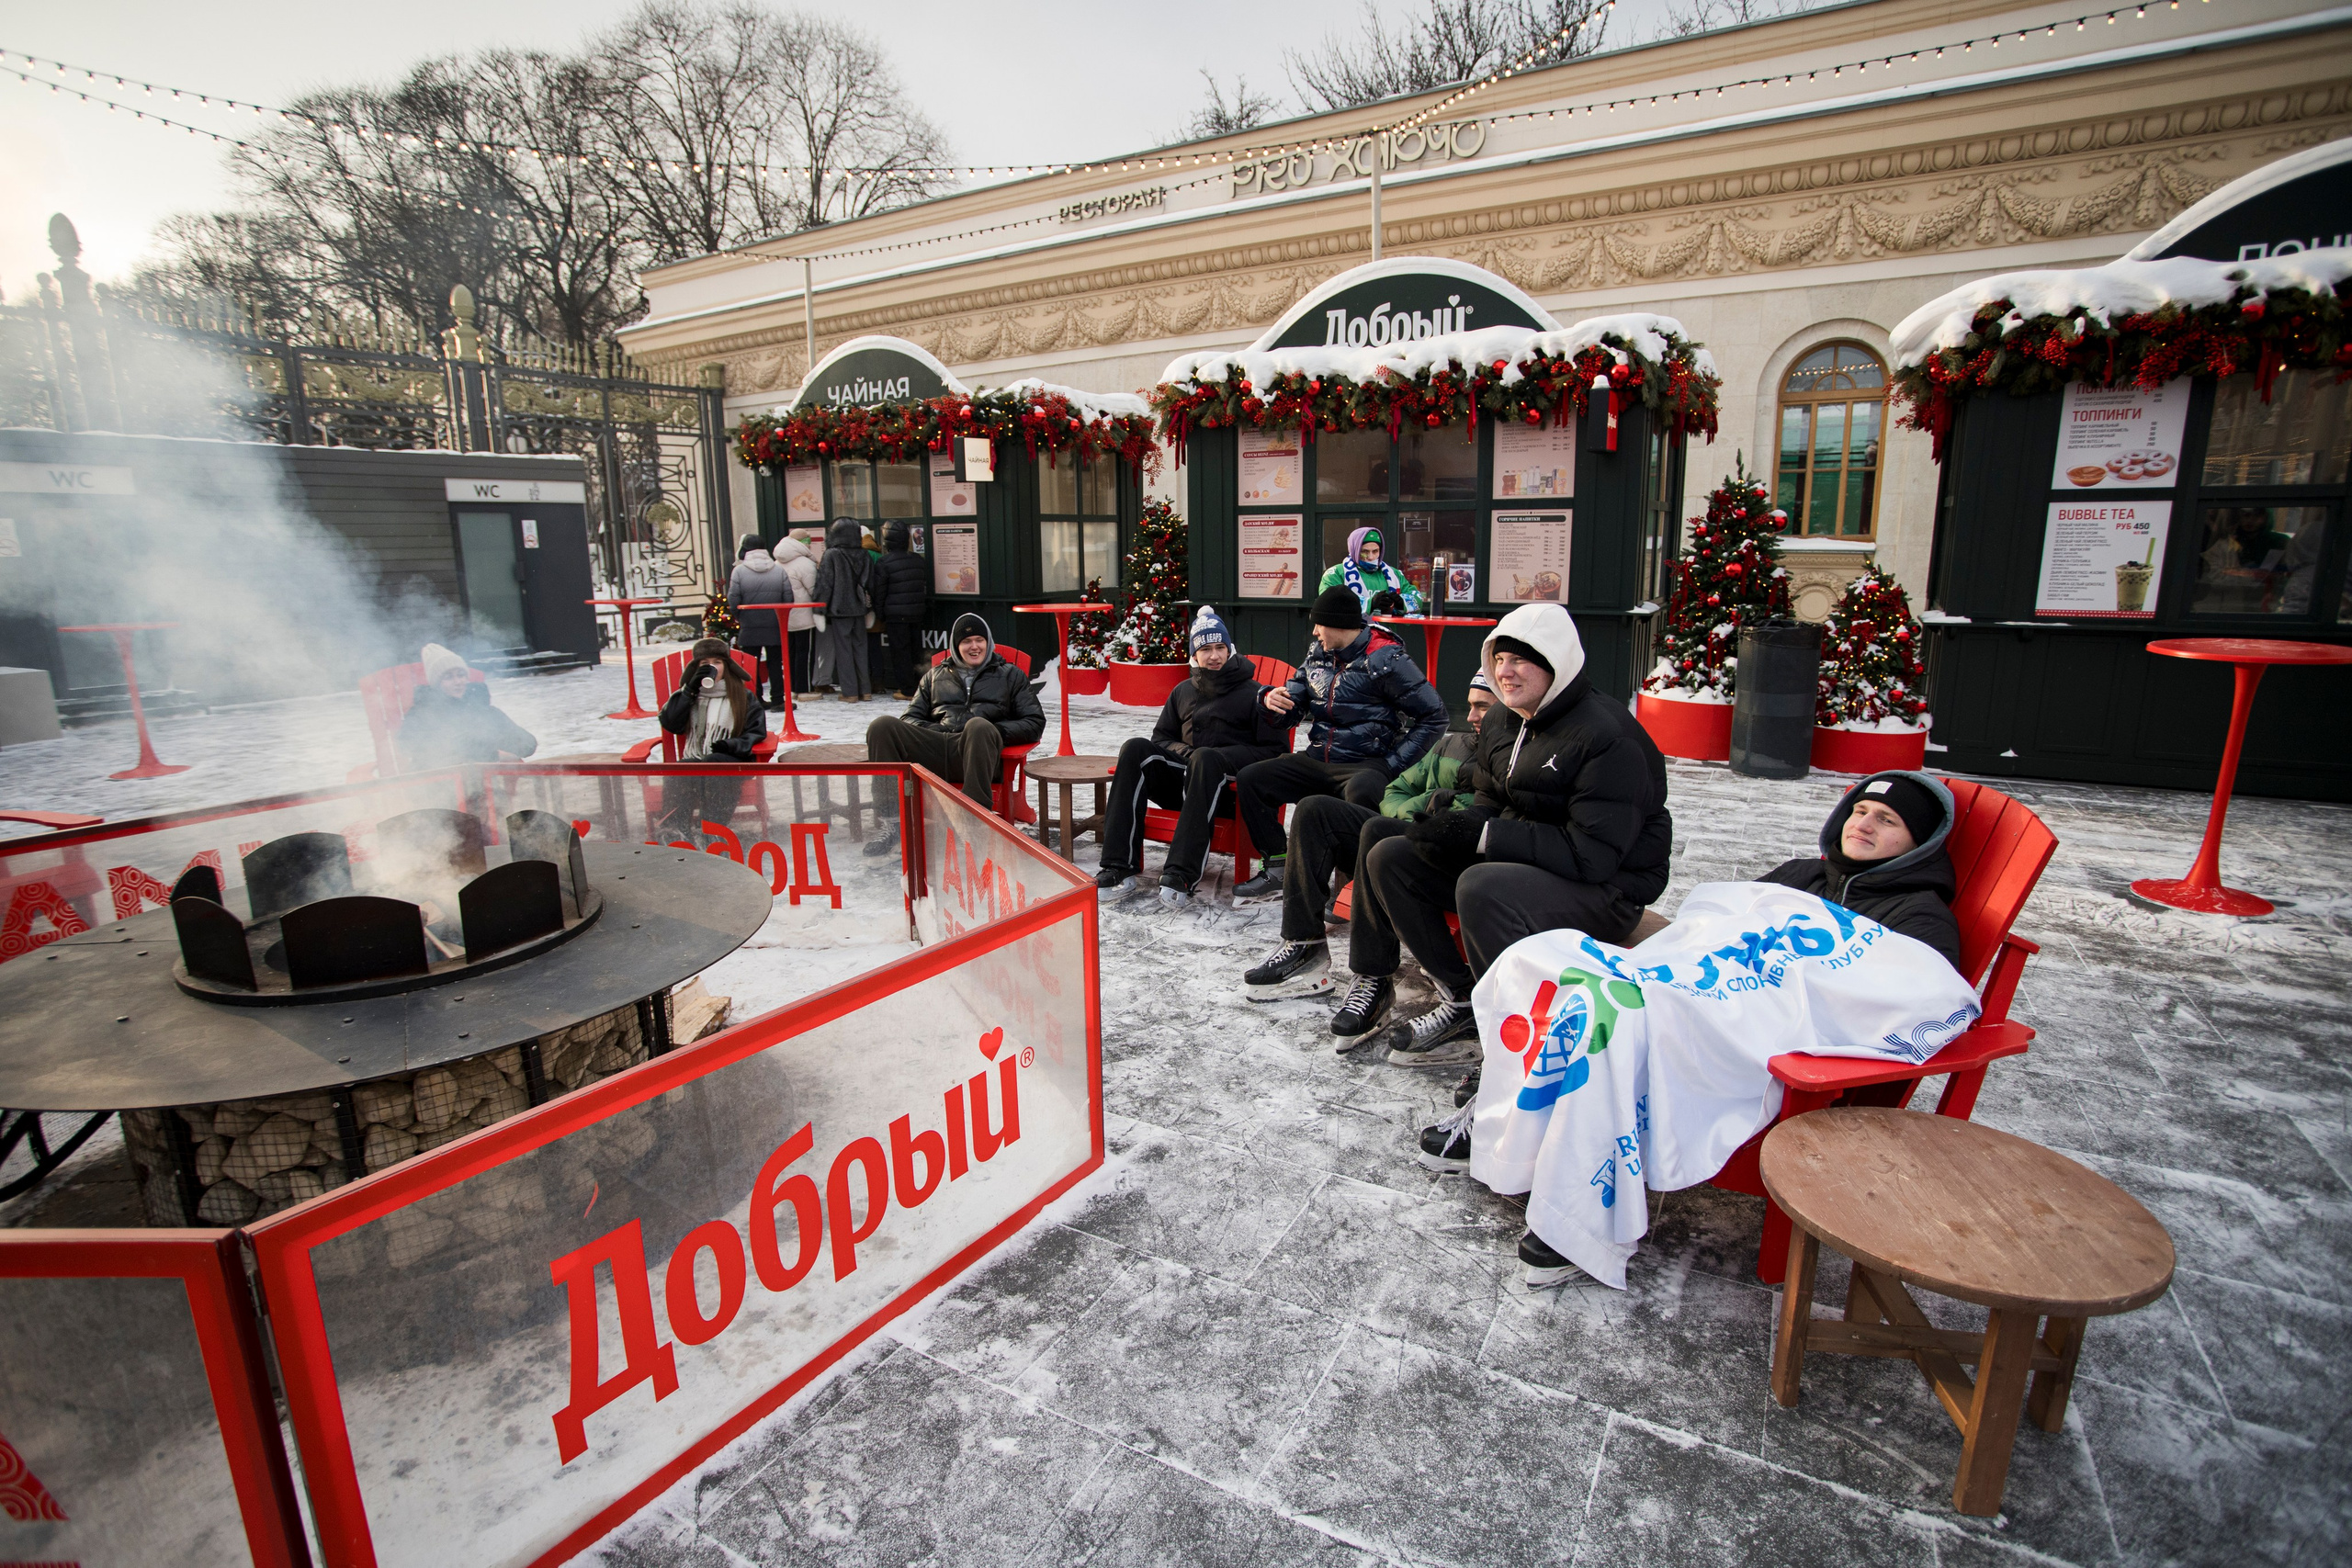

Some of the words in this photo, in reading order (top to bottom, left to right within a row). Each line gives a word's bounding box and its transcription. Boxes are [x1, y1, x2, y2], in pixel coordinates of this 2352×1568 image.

[1059, 186, 1163, 224] РЕСТОРАН
[1322, 295, 1465, 348] Добрый
[828, 377, 910, 404] ЧАЙНАЯ
[2073, 408, 2142, 422] ТОППИНГИ
[48, 470, 95, 489] WC
[473, 484, 501, 498] WC
[2058, 509, 2108, 521] BUBBLE
[2110, 508, 2135, 520] TEA
[2133, 522, 2150, 530] 450
[1206, 632, 1222, 643] LEAFS
[550, 1026, 1021, 1466] Добрый
